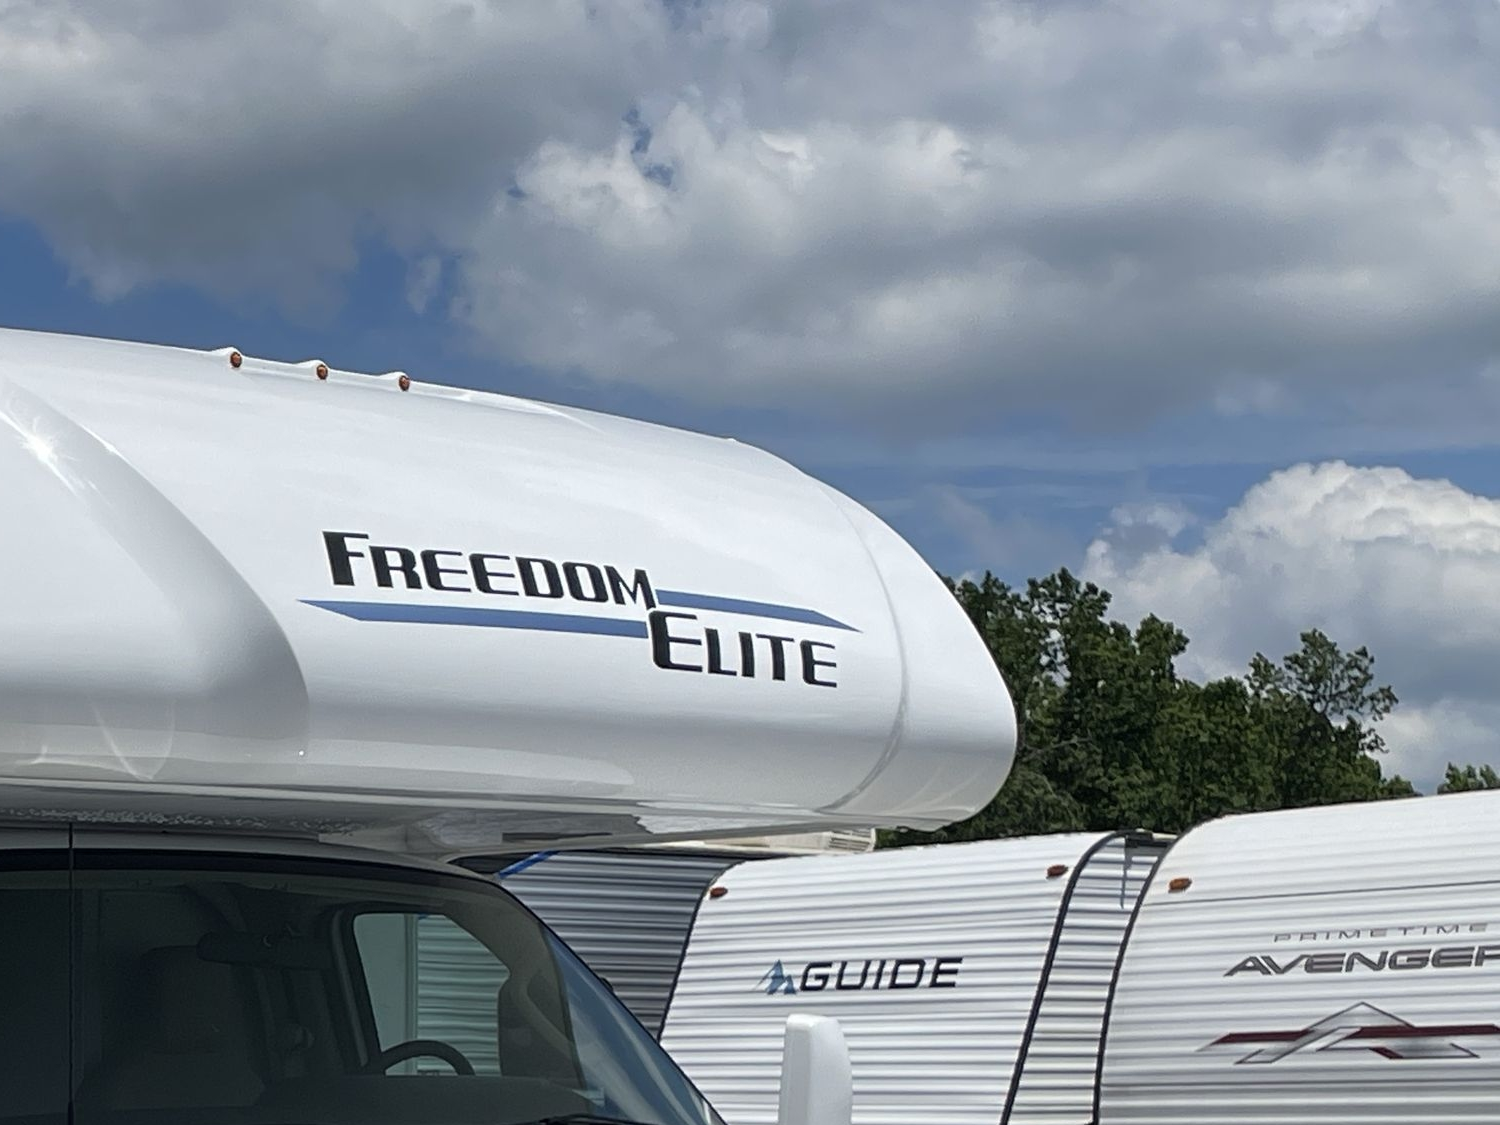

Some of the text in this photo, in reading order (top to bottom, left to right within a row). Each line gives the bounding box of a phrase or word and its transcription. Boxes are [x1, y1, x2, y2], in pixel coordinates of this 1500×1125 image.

[322, 530, 657, 609] FREEDOM
[647, 609, 838, 688] ELITE
[800, 956, 964, 992] GUIDE
